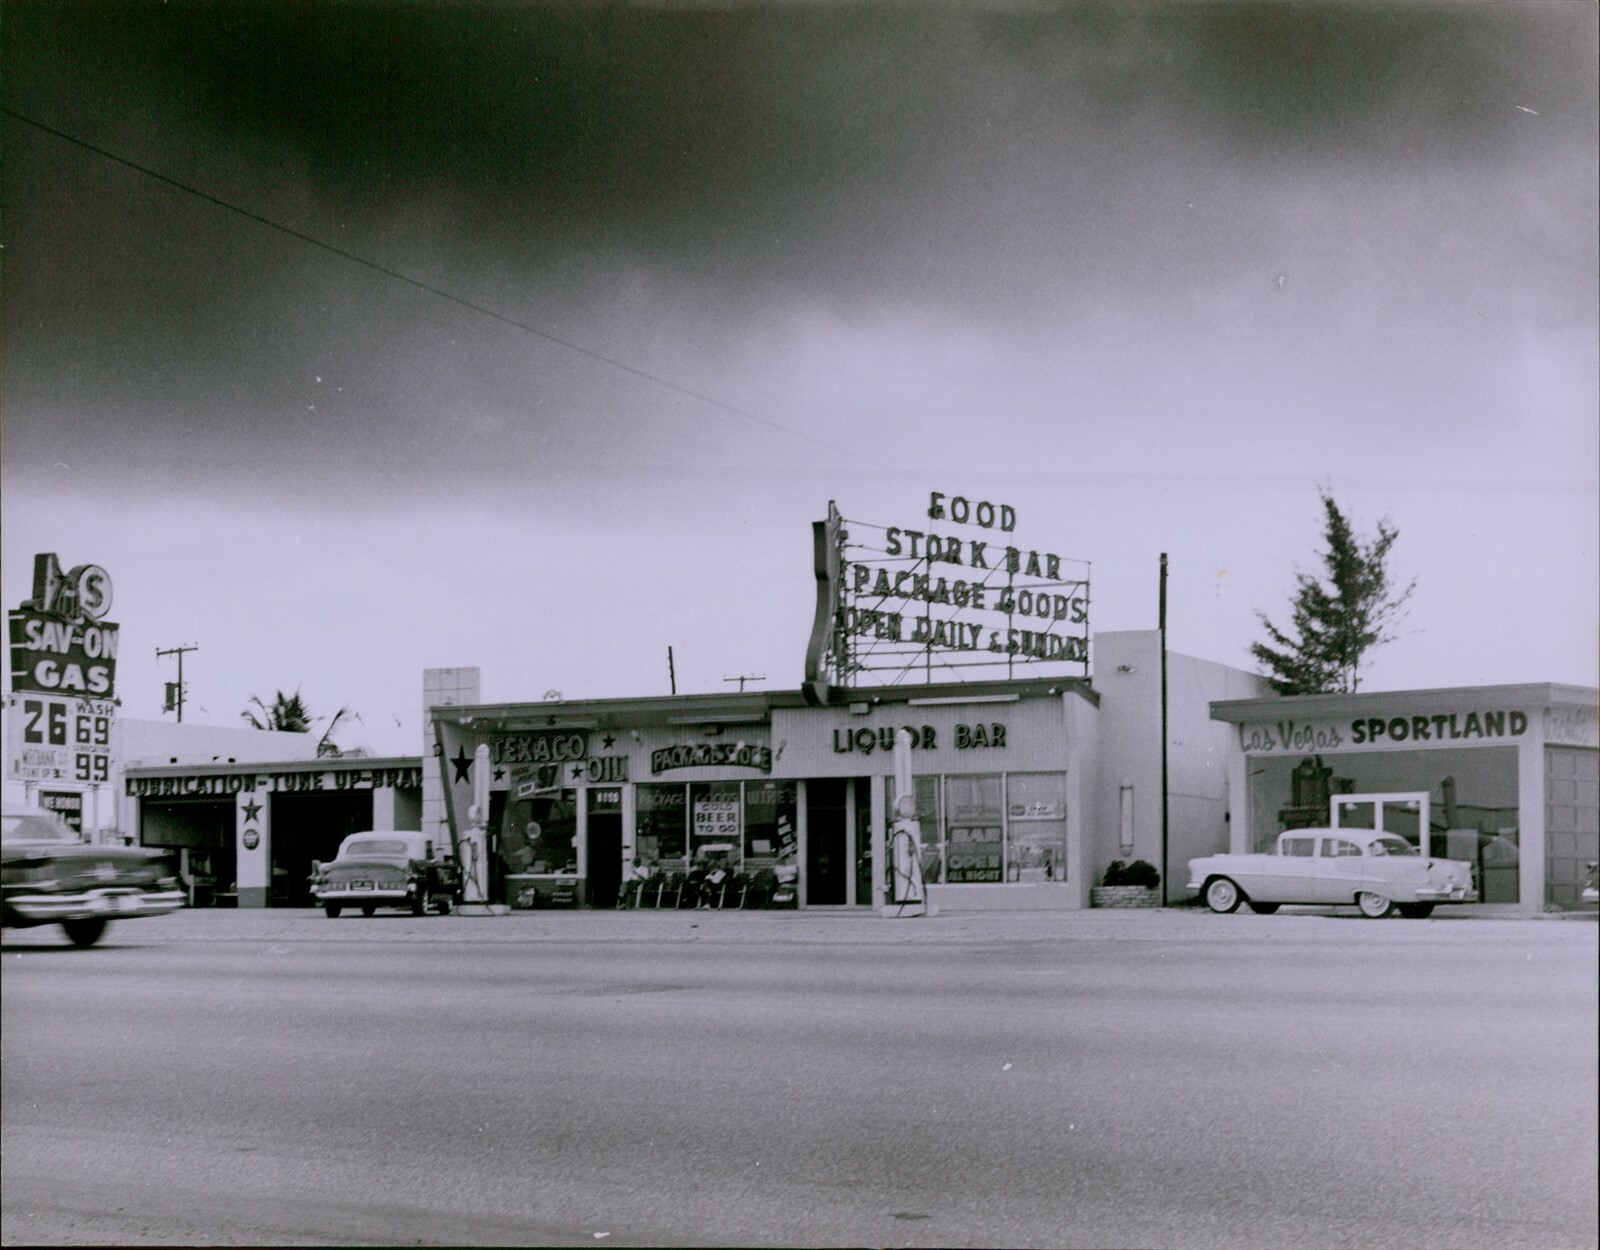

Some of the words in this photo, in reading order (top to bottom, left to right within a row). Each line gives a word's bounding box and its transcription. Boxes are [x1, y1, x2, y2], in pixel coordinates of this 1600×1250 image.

[930, 491, 1017, 531] FOOD
[886, 527, 988, 569] STORK
[1006, 546, 1060, 580] BAR
[854, 565, 985, 610] PACKAGE
[1000, 586, 1087, 623] GOODS
[25, 619, 118, 660] SAV-ON
[844, 606, 902, 642] OPEN
[916, 616, 982, 650] DAILY
[1006, 629, 1088, 662] SUNDAY
[34, 659, 109, 693] GAS
[24, 699, 67, 745] 26
[76, 702, 114, 717] WASH
[76, 715, 109, 745] 69
[833, 725, 937, 755] LIQUOR
[954, 722, 1007, 749] BAR
[1238, 722, 1277, 752] Las
[1277, 720, 1344, 751] Vegas
[1351, 710, 1528, 744] SPORTLAND
[492, 734, 585, 763] TEXACO
[653, 745, 719, 769] PACKAGE
[724, 744, 770, 768] STORE
[76, 753, 108, 781] 99
[586, 757, 626, 783] OIL
[696, 812, 736, 822] BEER
[702, 803, 733, 811] COLD
[951, 828, 1001, 843] BAR
[948, 855, 1000, 869] OPEN
[948, 870, 964, 881] ALL
